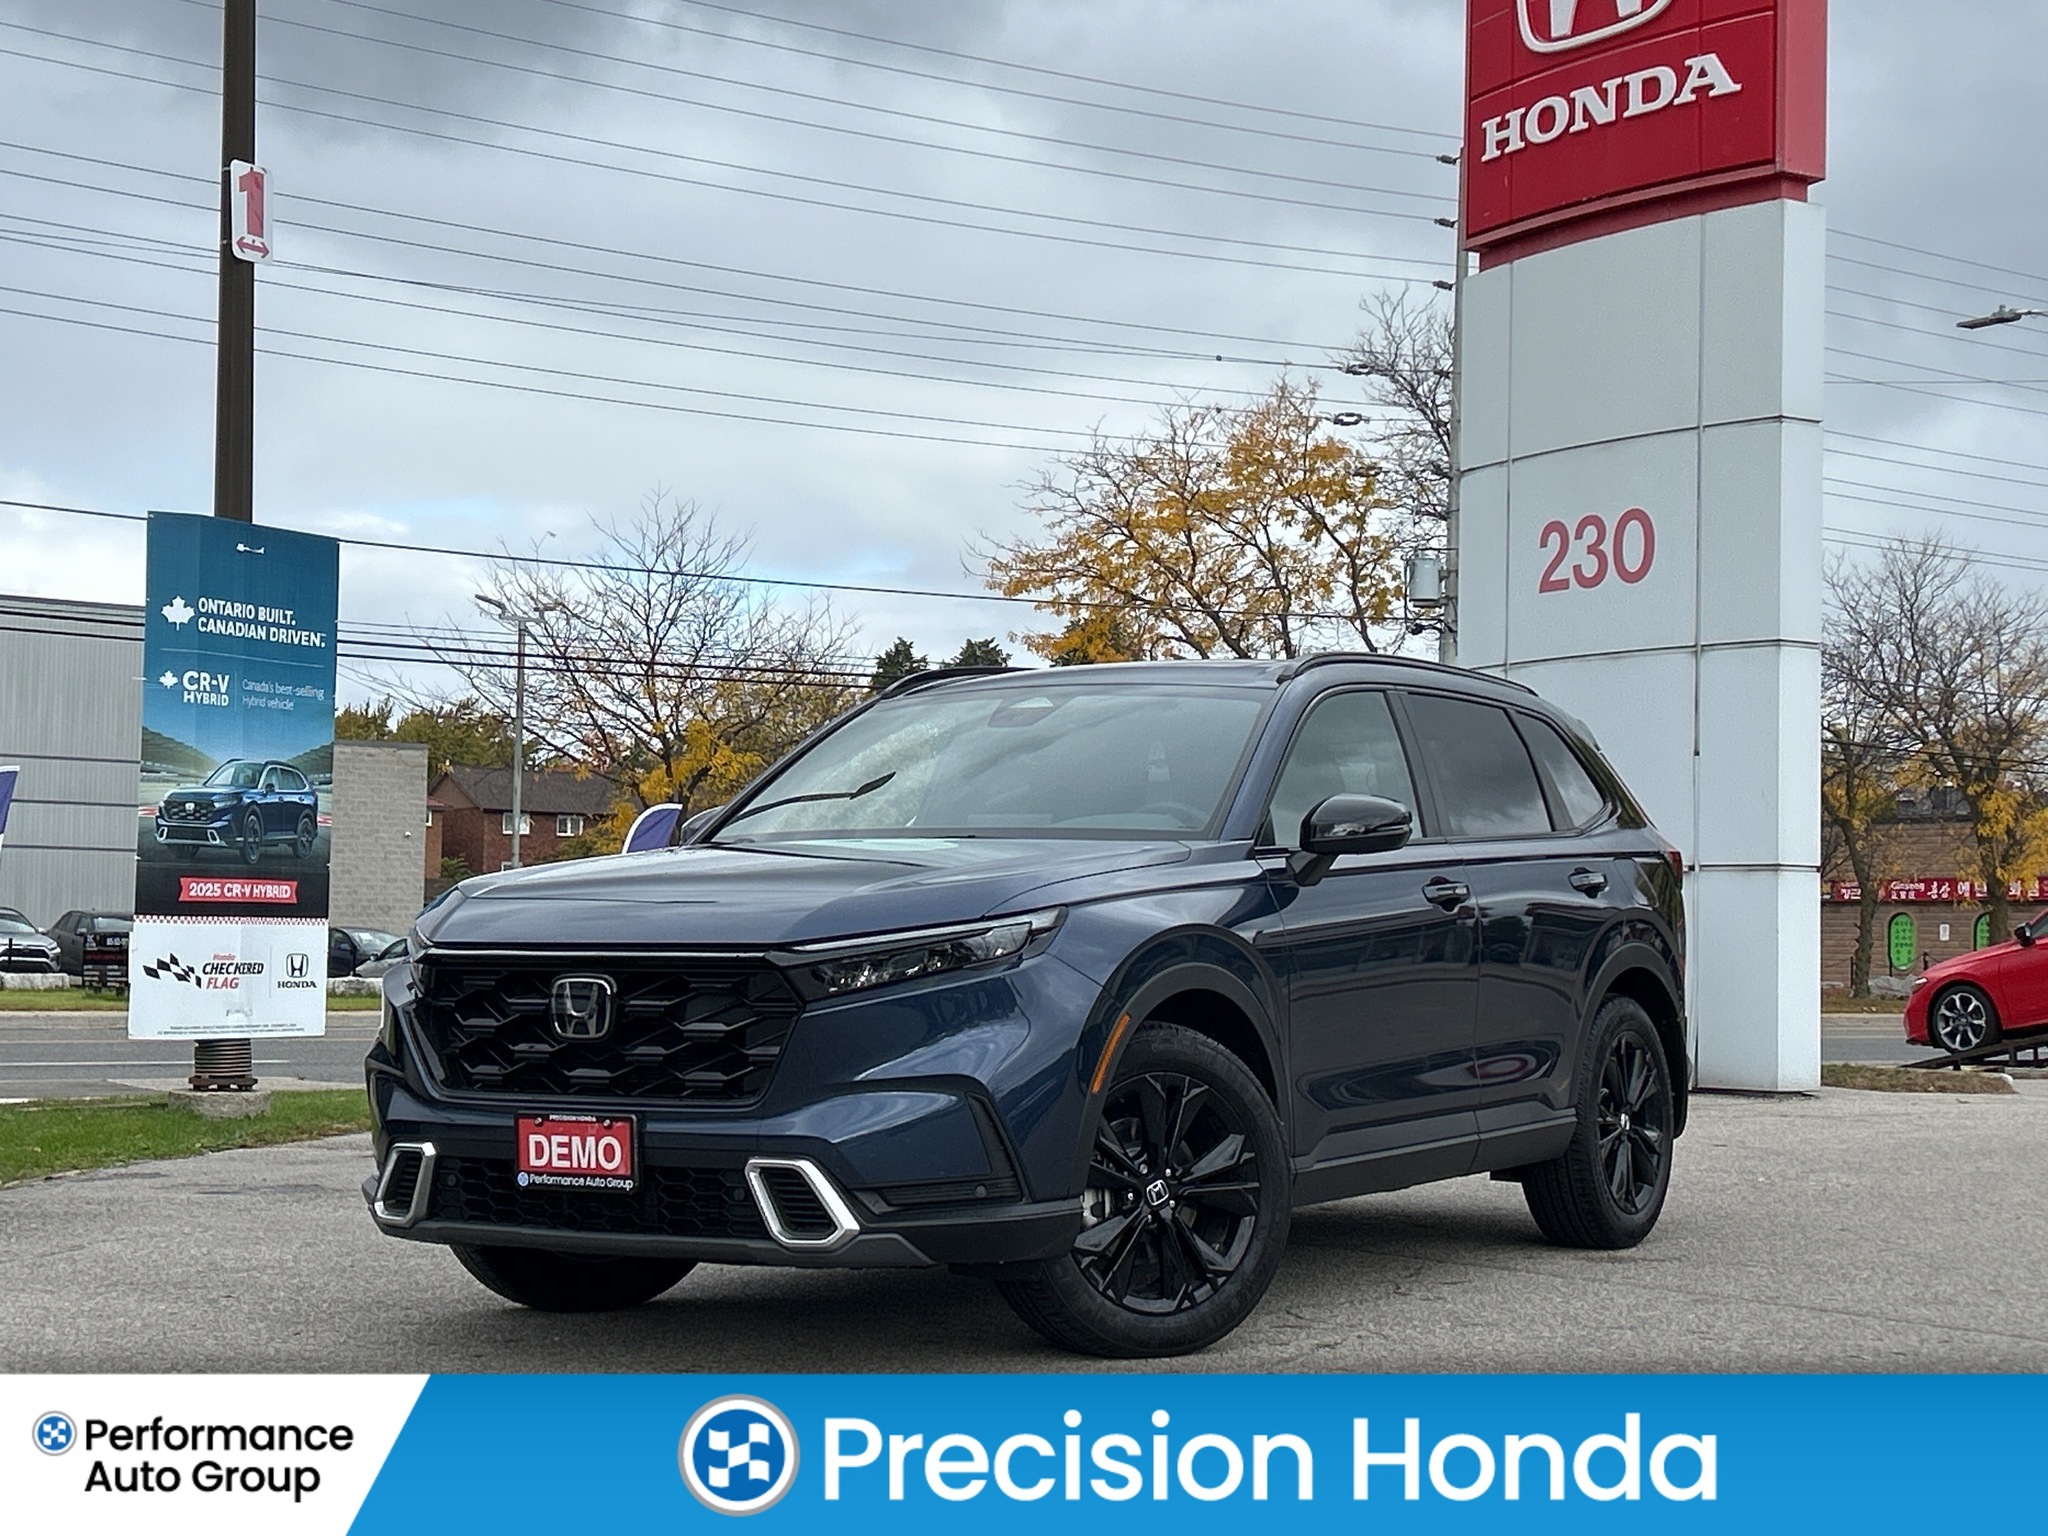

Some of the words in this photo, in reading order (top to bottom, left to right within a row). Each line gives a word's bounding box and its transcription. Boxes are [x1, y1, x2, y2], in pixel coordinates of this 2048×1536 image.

[1481, 52, 1742, 162] HONDA
[239, 170, 265, 238] 1
[1539, 508, 1655, 593] 230
[198, 597, 256, 620] ONTARIO
[257, 606, 297, 626] BUILT.
[198, 617, 267, 641] CANADIAN
[182, 670, 230, 694] CR-V
[242, 679, 274, 694] Canada's
[275, 682, 325, 701] best-selling
[183, 691, 229, 706] HYBRID
[267, 698, 294, 711] vehicle
[188, 882, 222, 897] 2025
[223, 883, 252, 898] CR-V
[252, 884, 292, 899] HYBRID
[1891, 881, 1925, 892] Ginseng
[202, 962, 265, 976] CHECKERED
[206, 977, 240, 989] FLAG
[277, 980, 317, 989] HONDA
[528, 1134, 622, 1171] DEMO
[529, 1173, 585, 1187] Performance
[585, 1177, 606, 1188] Auto
[606, 1177, 634, 1191] Group
